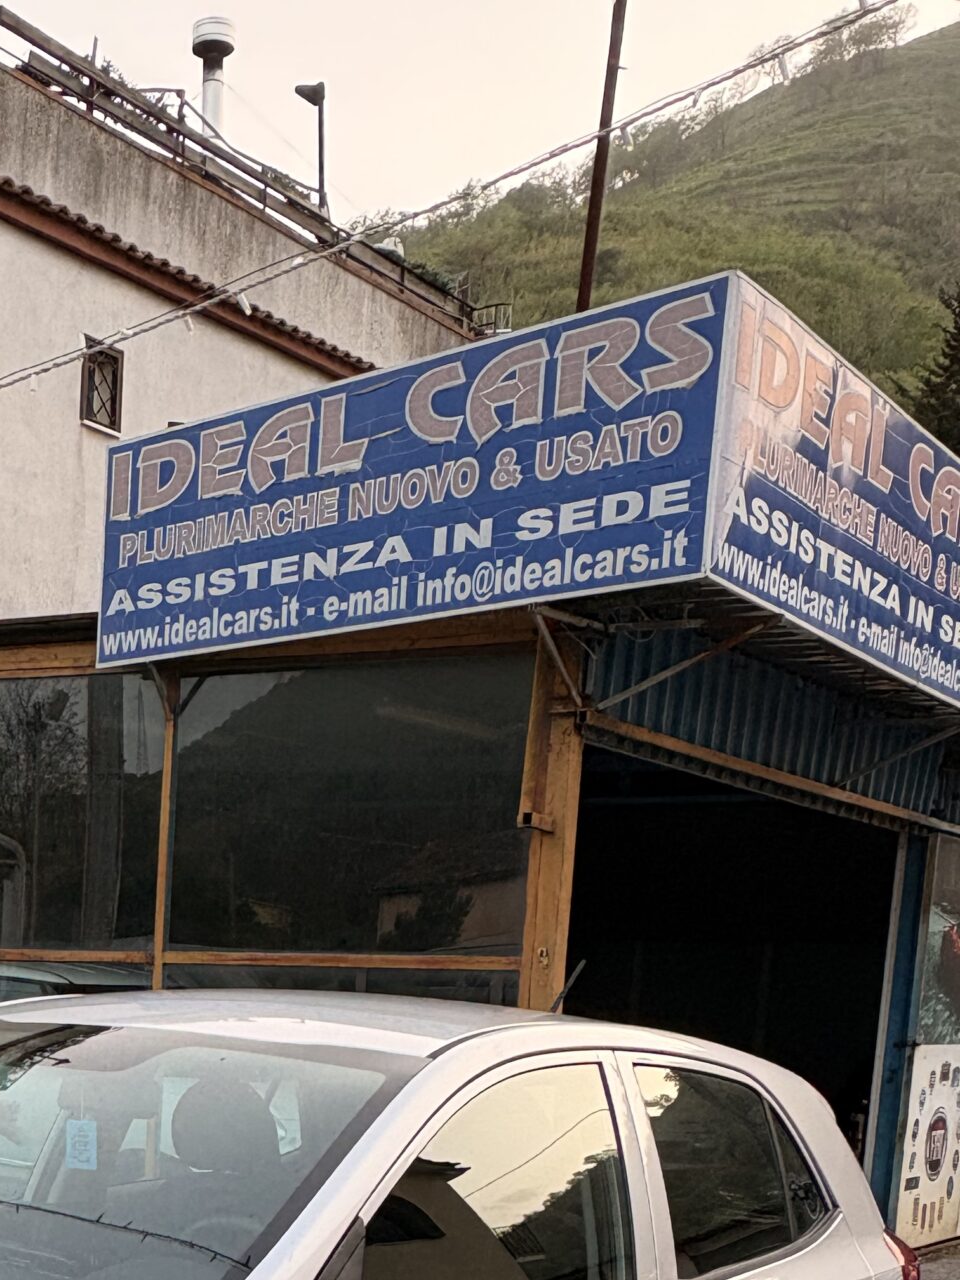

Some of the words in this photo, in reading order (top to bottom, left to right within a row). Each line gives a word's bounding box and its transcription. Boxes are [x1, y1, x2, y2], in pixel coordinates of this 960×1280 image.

[110, 393, 369, 521] IDEAL
[405, 292, 715, 447] CARS
[734, 299, 894, 494] IDEAL
[105, 535, 413, 616] ASSISTENZA
[433, 518, 493, 556] IN
[515, 480, 691, 541] SEDE
[119, 487, 339, 568] PLURIMARCHE
[348, 457, 480, 522] NUOVO
[490, 447, 523, 491] &
[535, 410, 683, 481] USATO
[724, 486, 901, 616] ASSISTENZA
[907, 595, 934, 633] IN
[738, 417, 878, 547] PLURIMARCHE
[877, 512, 933, 582] NUOVO
[935, 553, 947, 592] &
[102, 596, 299, 656] www.idealcars.it
[323, 576, 407, 621] e-mail
[417, 529, 688, 607] info@idealcars.it
[718, 543, 849, 633] www.idealcars.it
[858, 616, 898, 659] e-mail
